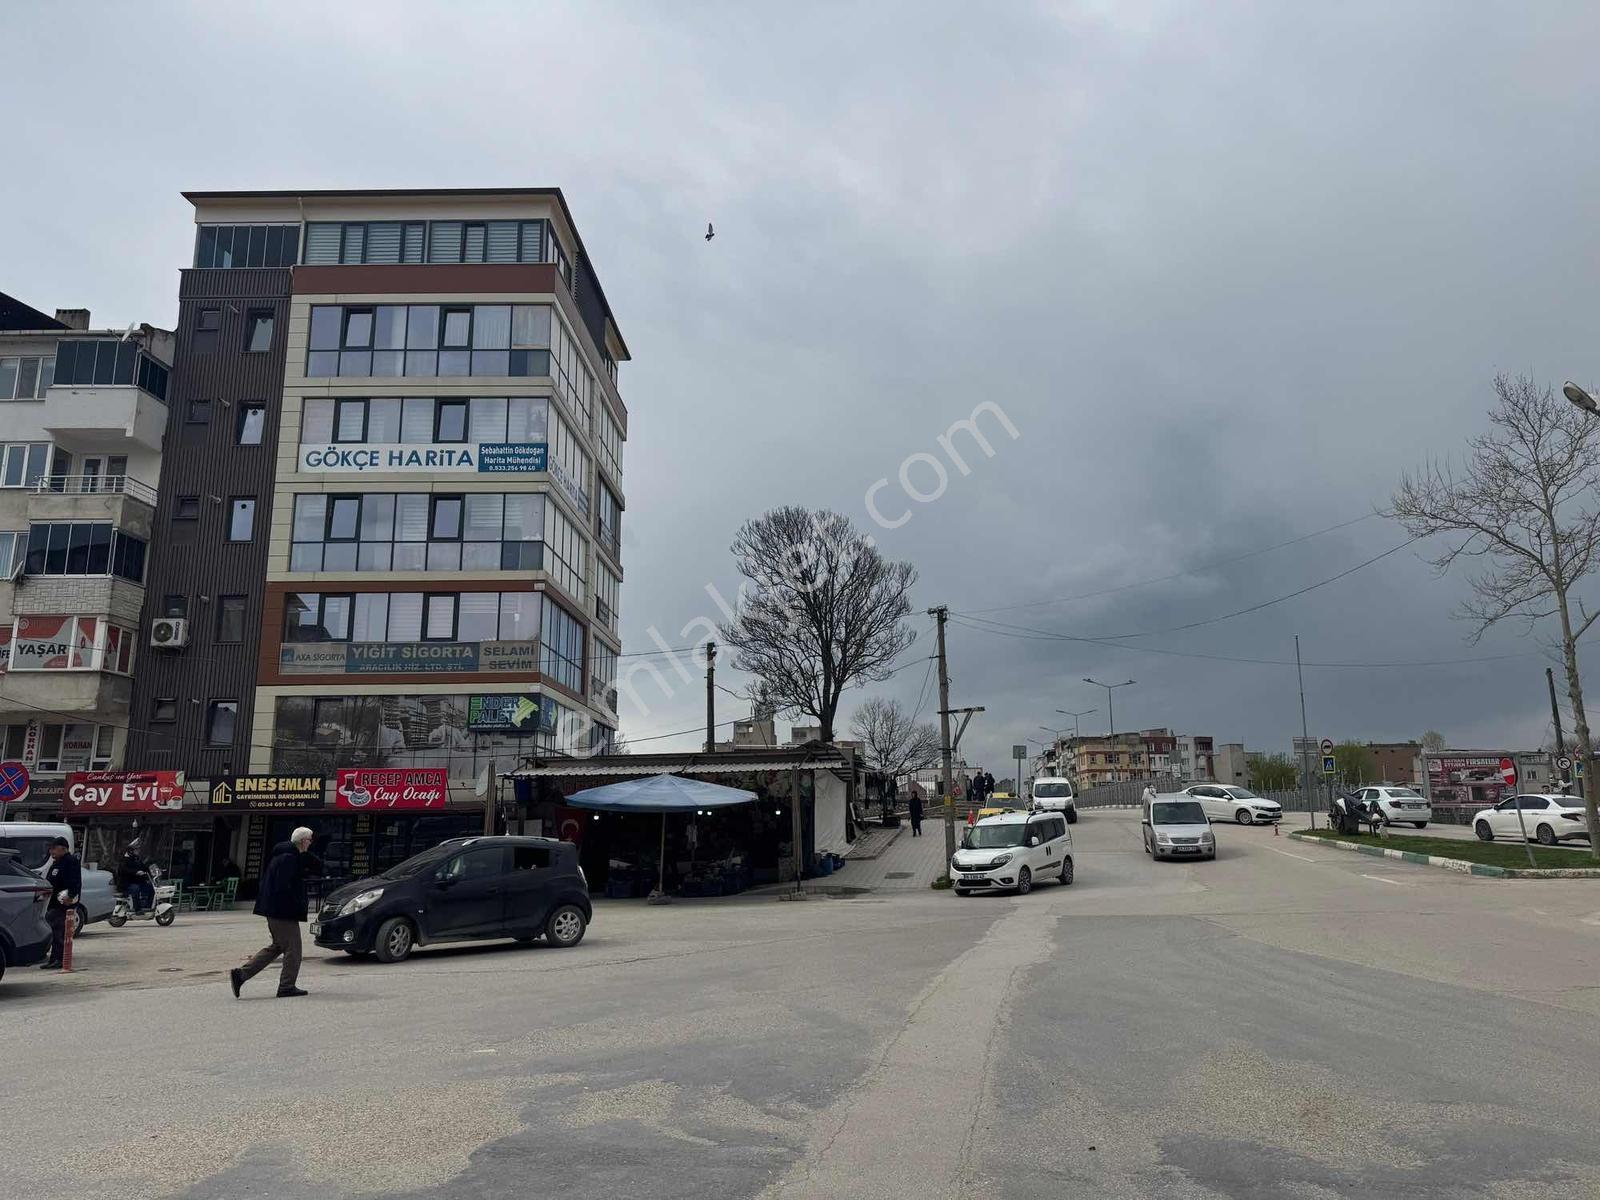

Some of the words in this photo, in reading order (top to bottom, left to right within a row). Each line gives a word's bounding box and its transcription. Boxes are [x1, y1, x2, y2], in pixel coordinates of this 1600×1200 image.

[305, 446, 379, 471] GÖKÇE
[484, 456, 506, 464] Harita
[18, 644, 67, 658] YAŞAR
[295, 653, 311, 662] AXA
[401, 643, 473, 658] SİGORTA
[483, 644, 535, 657] SELAMİ
[488, 657, 532, 670] SEVİM
[470, 696, 520, 710] ENDER
[470, 710, 517, 724] PALET
[25, 725, 37, 761] KORHAN
[235, 778, 277, 792] ENES
[278, 777, 321, 791] EMLAK
[361, 772, 401, 786] RECEP
[405, 771, 442, 786] AMCA
[69, 783, 112, 806] Çay
[122, 781, 158, 801] Evi
[374, 787, 400, 807] Çay
[403, 787, 441, 806] Ocağı
